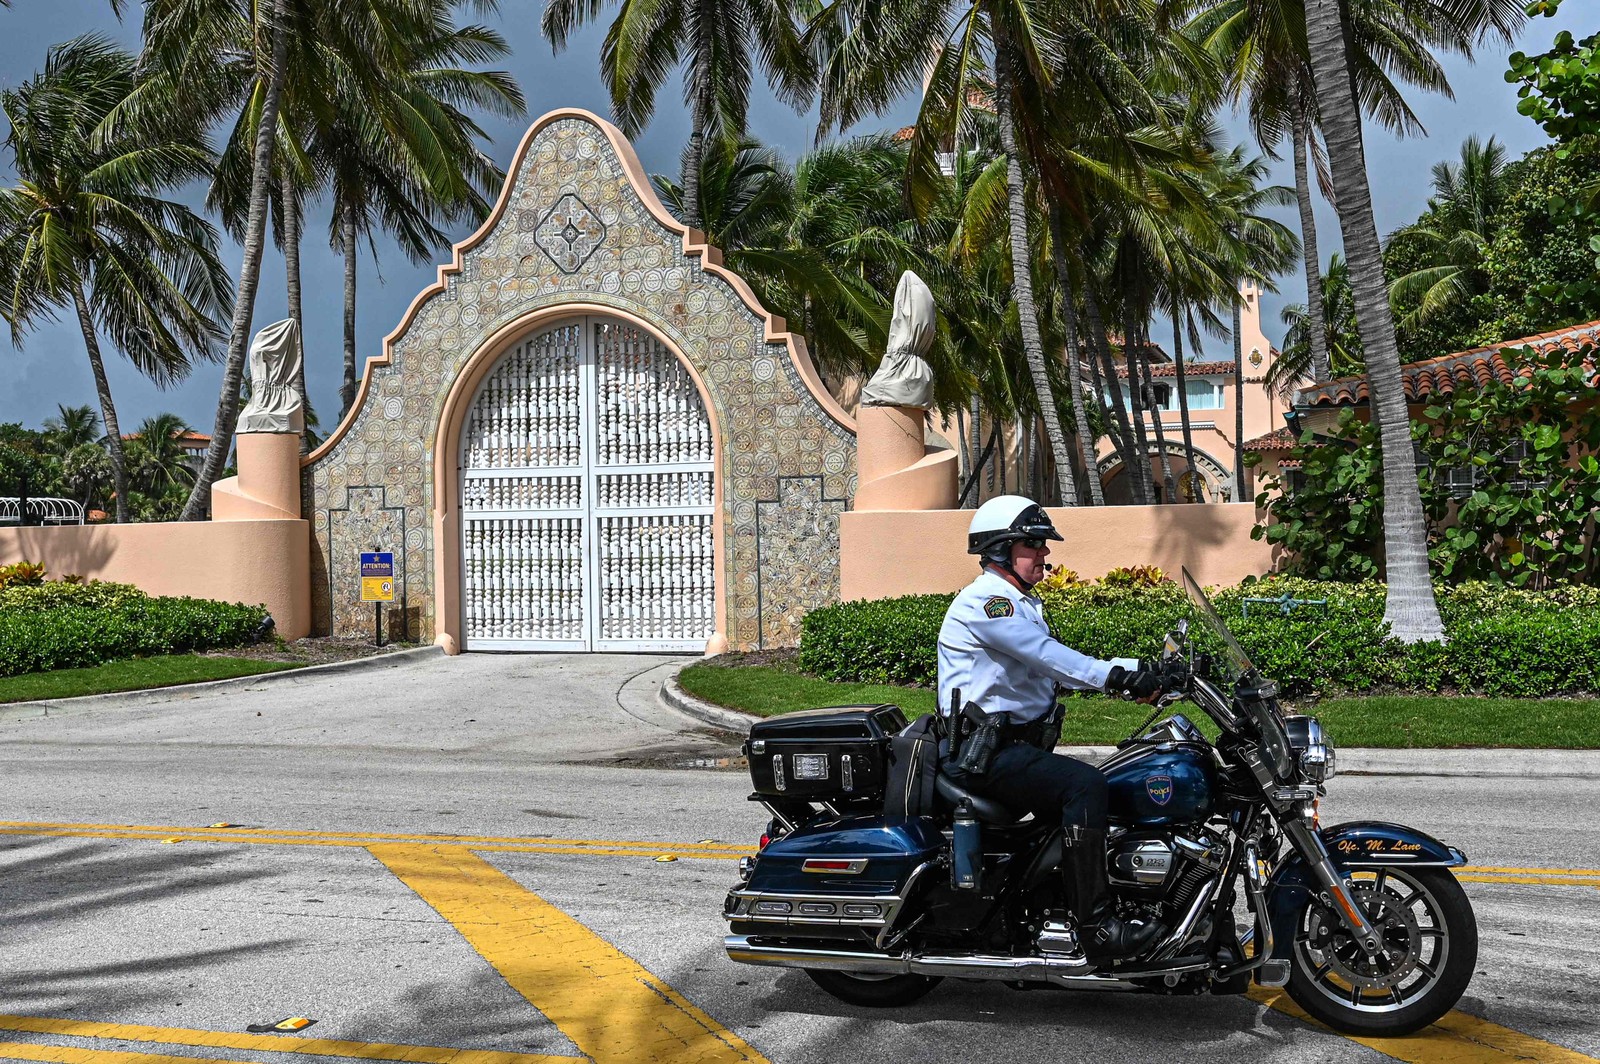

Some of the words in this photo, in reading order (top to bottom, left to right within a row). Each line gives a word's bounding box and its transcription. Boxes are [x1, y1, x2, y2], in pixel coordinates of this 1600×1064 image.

[1150, 786, 1170, 795] POLICE
[1338, 840, 1360, 853] Ofc.
[1366, 840, 1386, 850] M.
[1391, 840, 1422, 851] Lane
